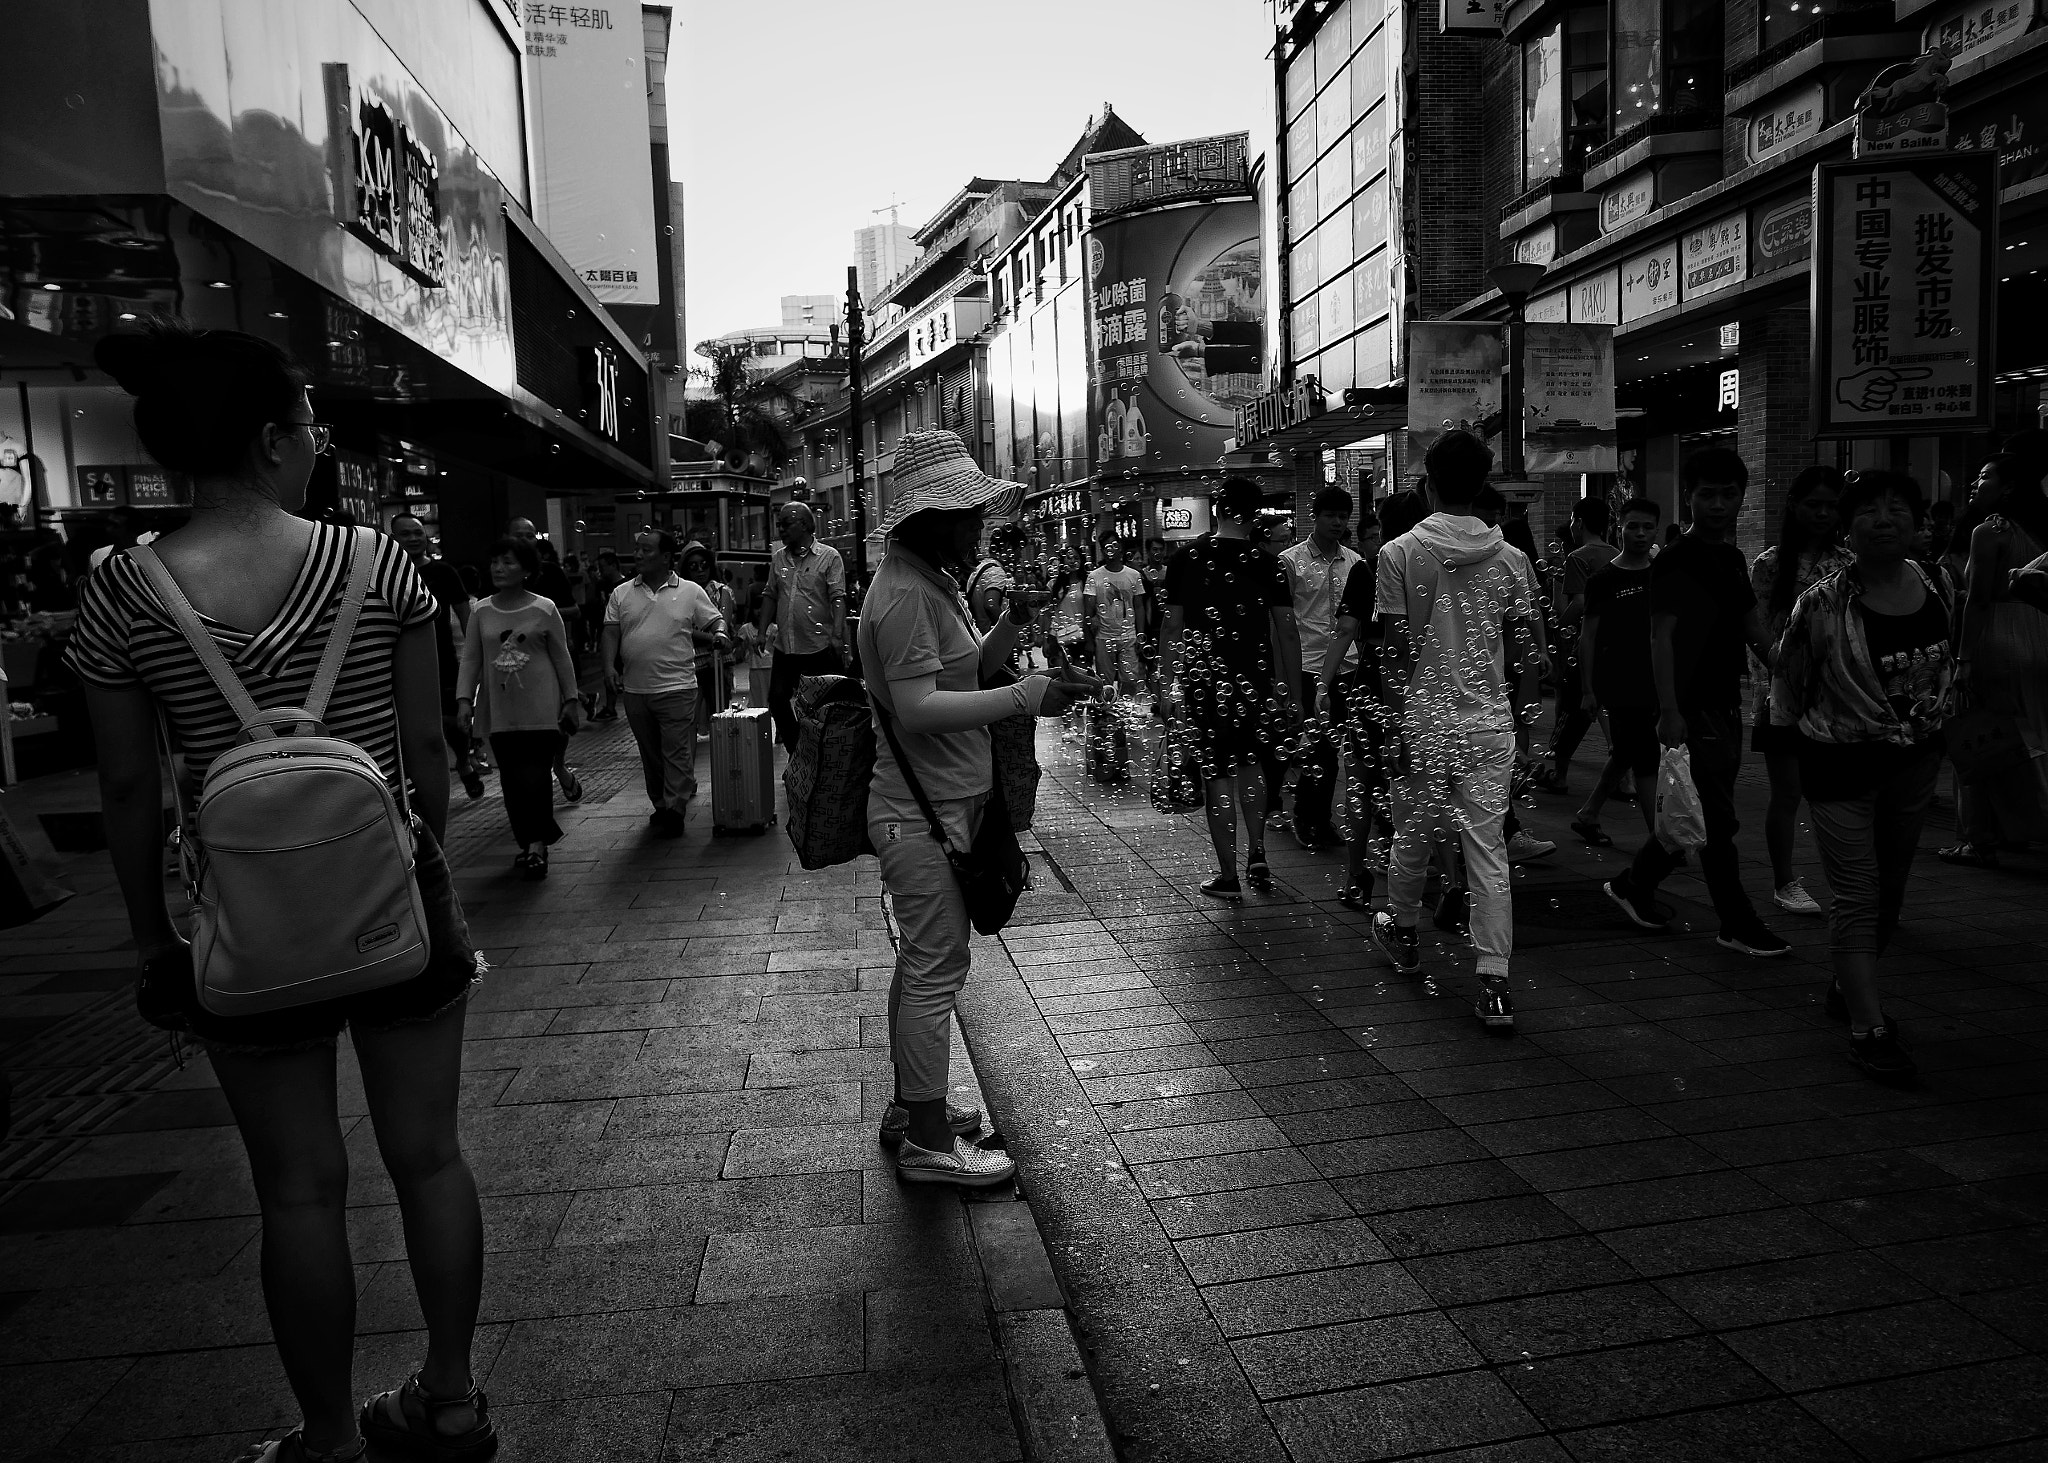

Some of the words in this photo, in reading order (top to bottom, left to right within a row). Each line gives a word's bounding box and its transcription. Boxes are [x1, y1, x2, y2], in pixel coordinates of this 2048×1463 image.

[1875, 106, 1932, 138] 新白马
[1868, 140, 1895, 151] New
[1901, 136, 1940, 149] BaiMa
[1853, 176, 1892, 366] 中国专业服饰
[1915, 212, 1954, 340] 批发市场
[1581, 281, 1607, 320] RAKU
[1718, 368, 1740, 412] 周
[672, 482, 701, 492] POLICE
